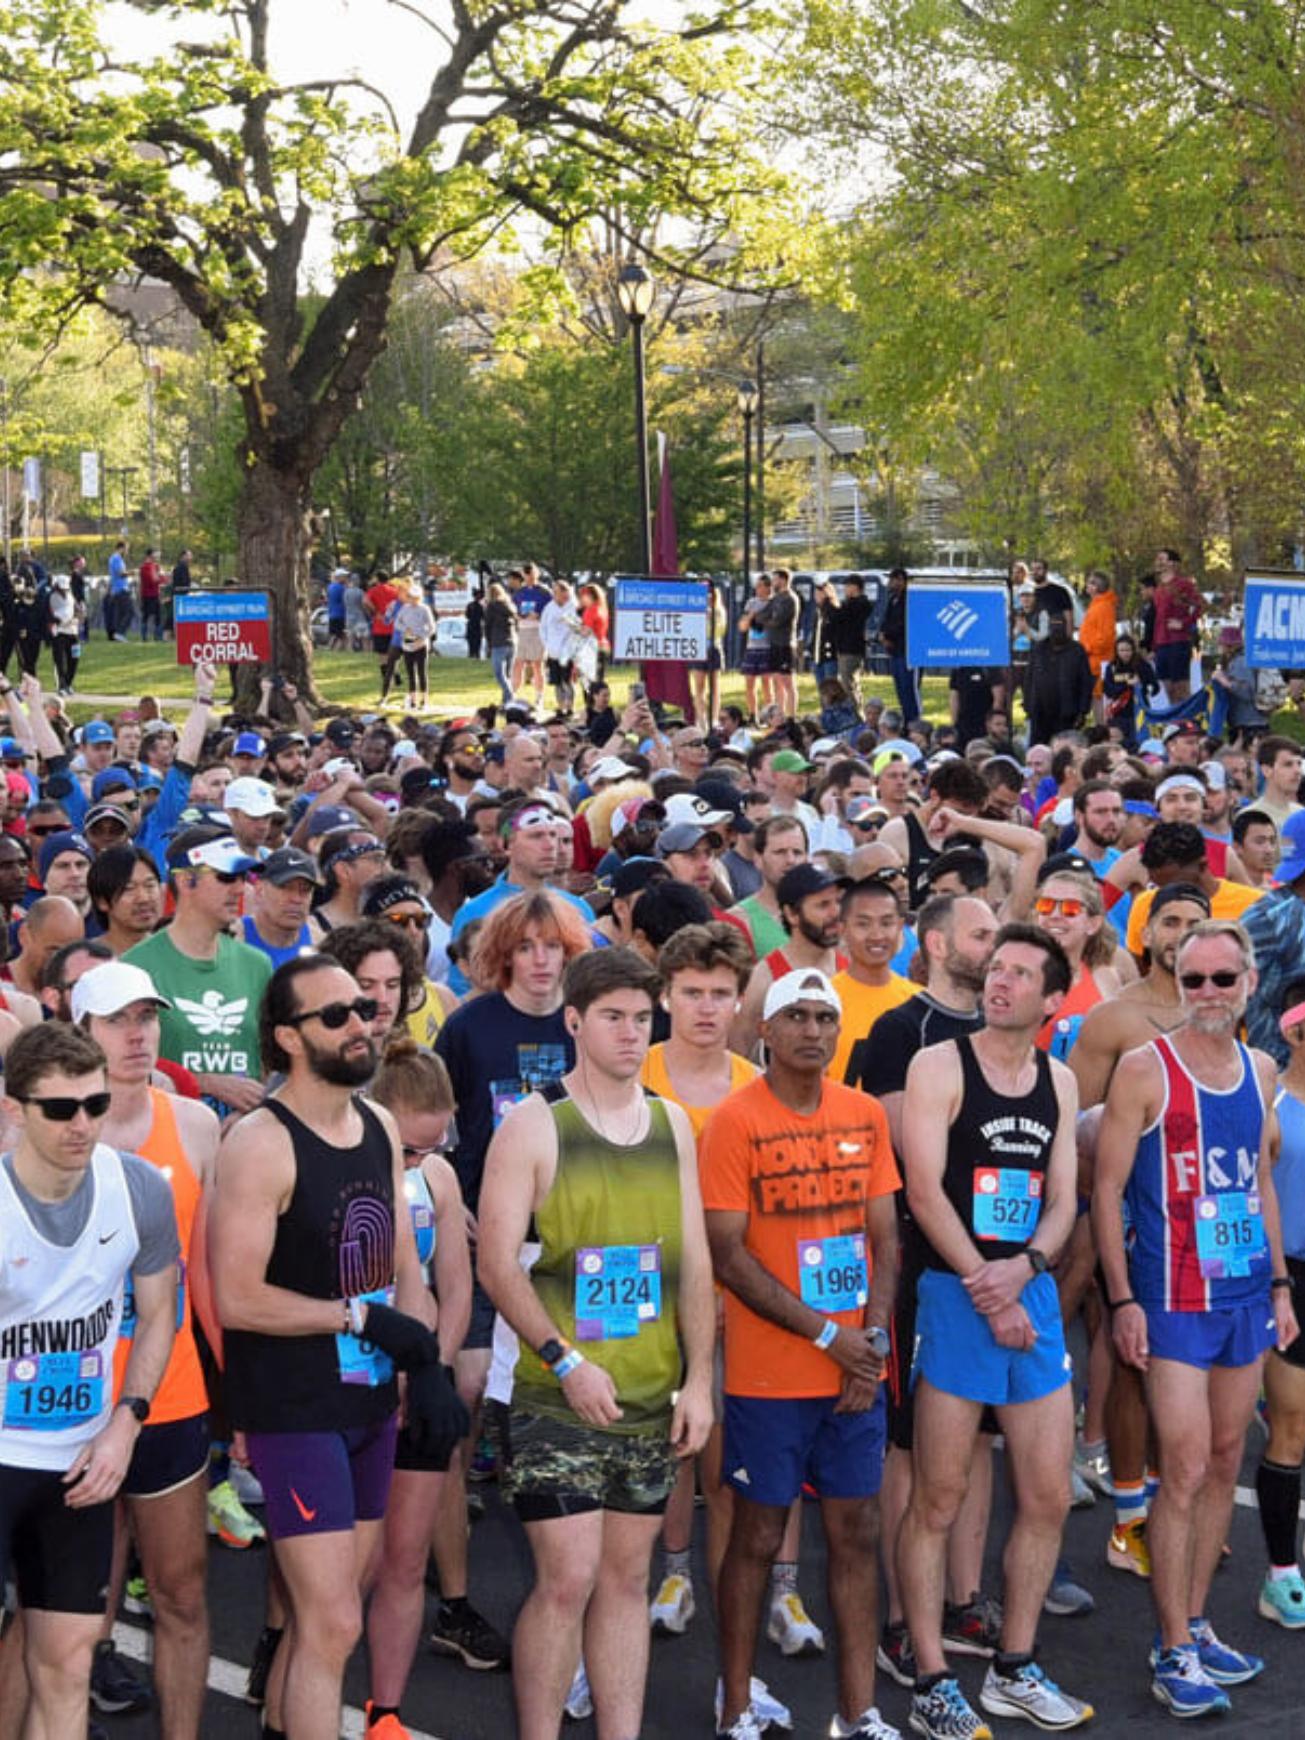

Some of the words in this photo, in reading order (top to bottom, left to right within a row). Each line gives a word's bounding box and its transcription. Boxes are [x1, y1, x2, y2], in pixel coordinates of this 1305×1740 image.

[207, 622, 240, 642] RED
[642, 611, 682, 634] ELITE
[190, 641, 259, 663] CORRAL
[625, 636, 698, 659] ATHLETES
[183, 1051, 248, 1073] RWB
[981, 1117, 1016, 1140] INSIDE
[1018, 1117, 1052, 1143] TRACK
[990, 1136, 1042, 1158] Running
[992, 1198, 1031, 1225] 527
[1215, 1219, 1252, 1246] 815
[587, 1275, 651, 1306] 2124
[19, 1382, 92, 1414] 1946
